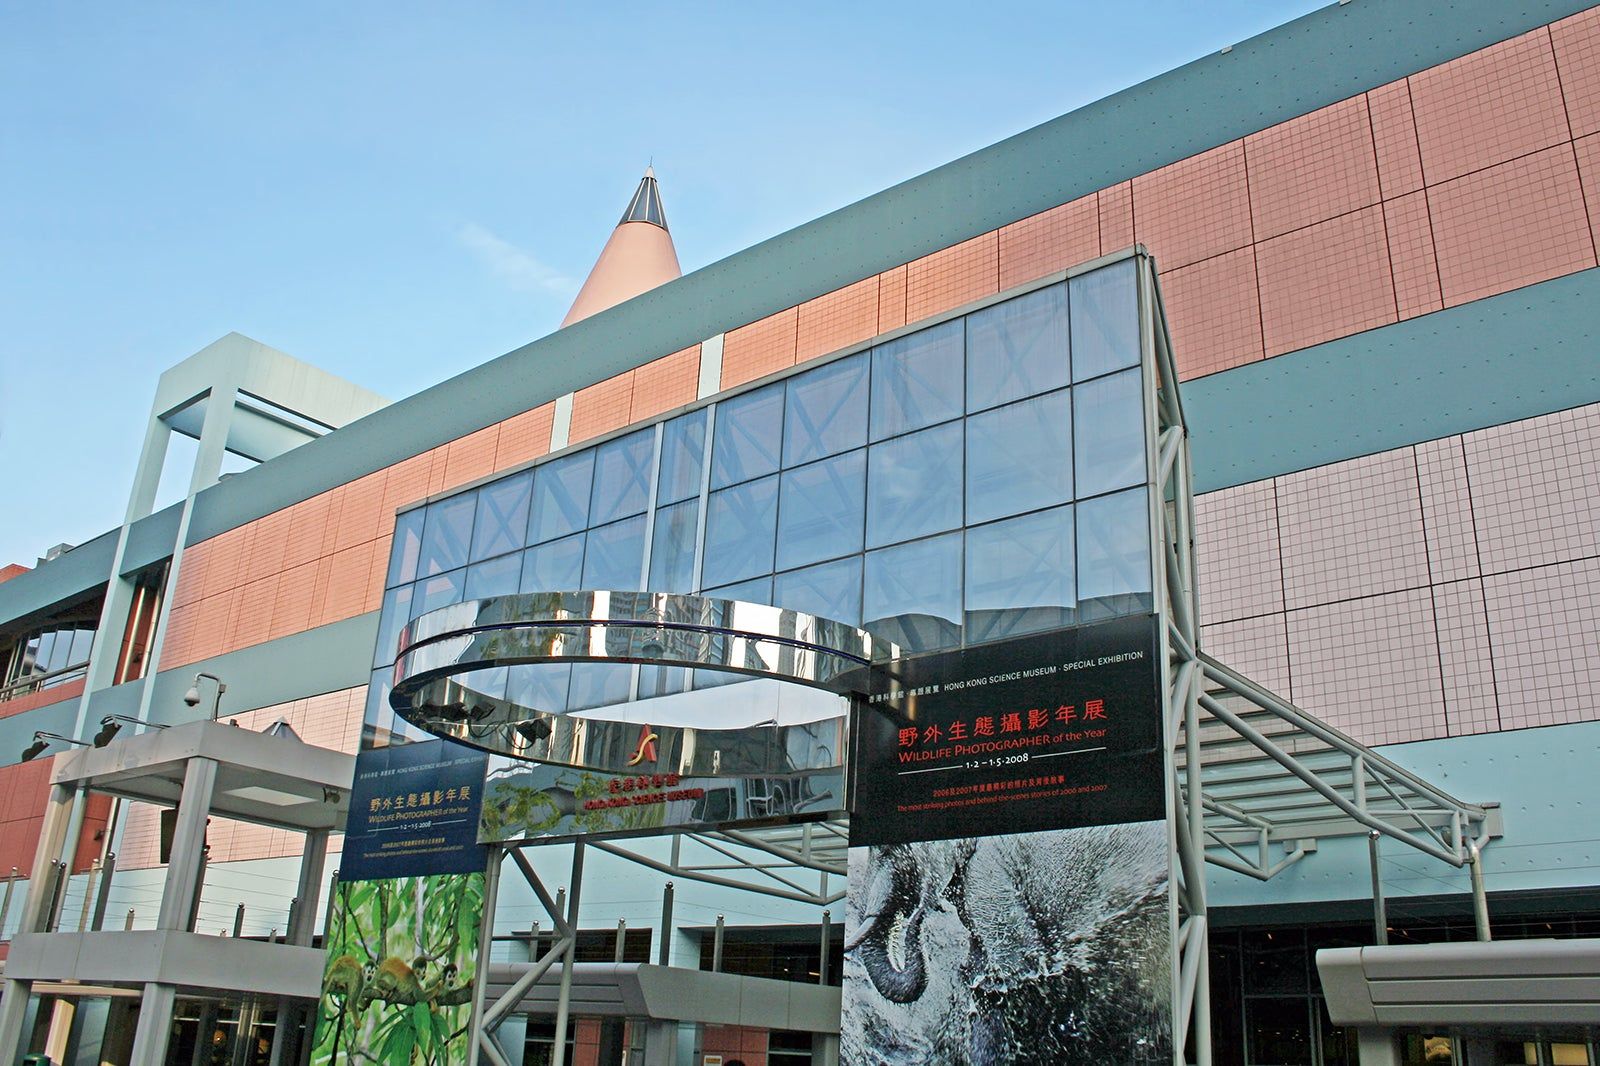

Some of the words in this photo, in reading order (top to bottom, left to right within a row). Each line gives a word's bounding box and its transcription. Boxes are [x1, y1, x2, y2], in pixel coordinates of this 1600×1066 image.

[944, 681, 964, 692] HONG
[966, 677, 987, 688] KONG
[988, 671, 1021, 684] SCIENCE
[1023, 665, 1057, 679] MUSEUM
[1063, 659, 1096, 672] SPECIAL
[1098, 651, 1143, 666] EXHIBITION
[898, 699, 1108, 748] 野外生態攝影年展
[898, 747, 952, 763] WILDLIFE
[954, 735, 1051, 757] PHOTOGRAPHER
[1053, 733, 1064, 743] of
[1065, 731, 1082, 741] the
[1084, 728, 1107, 739] Year
